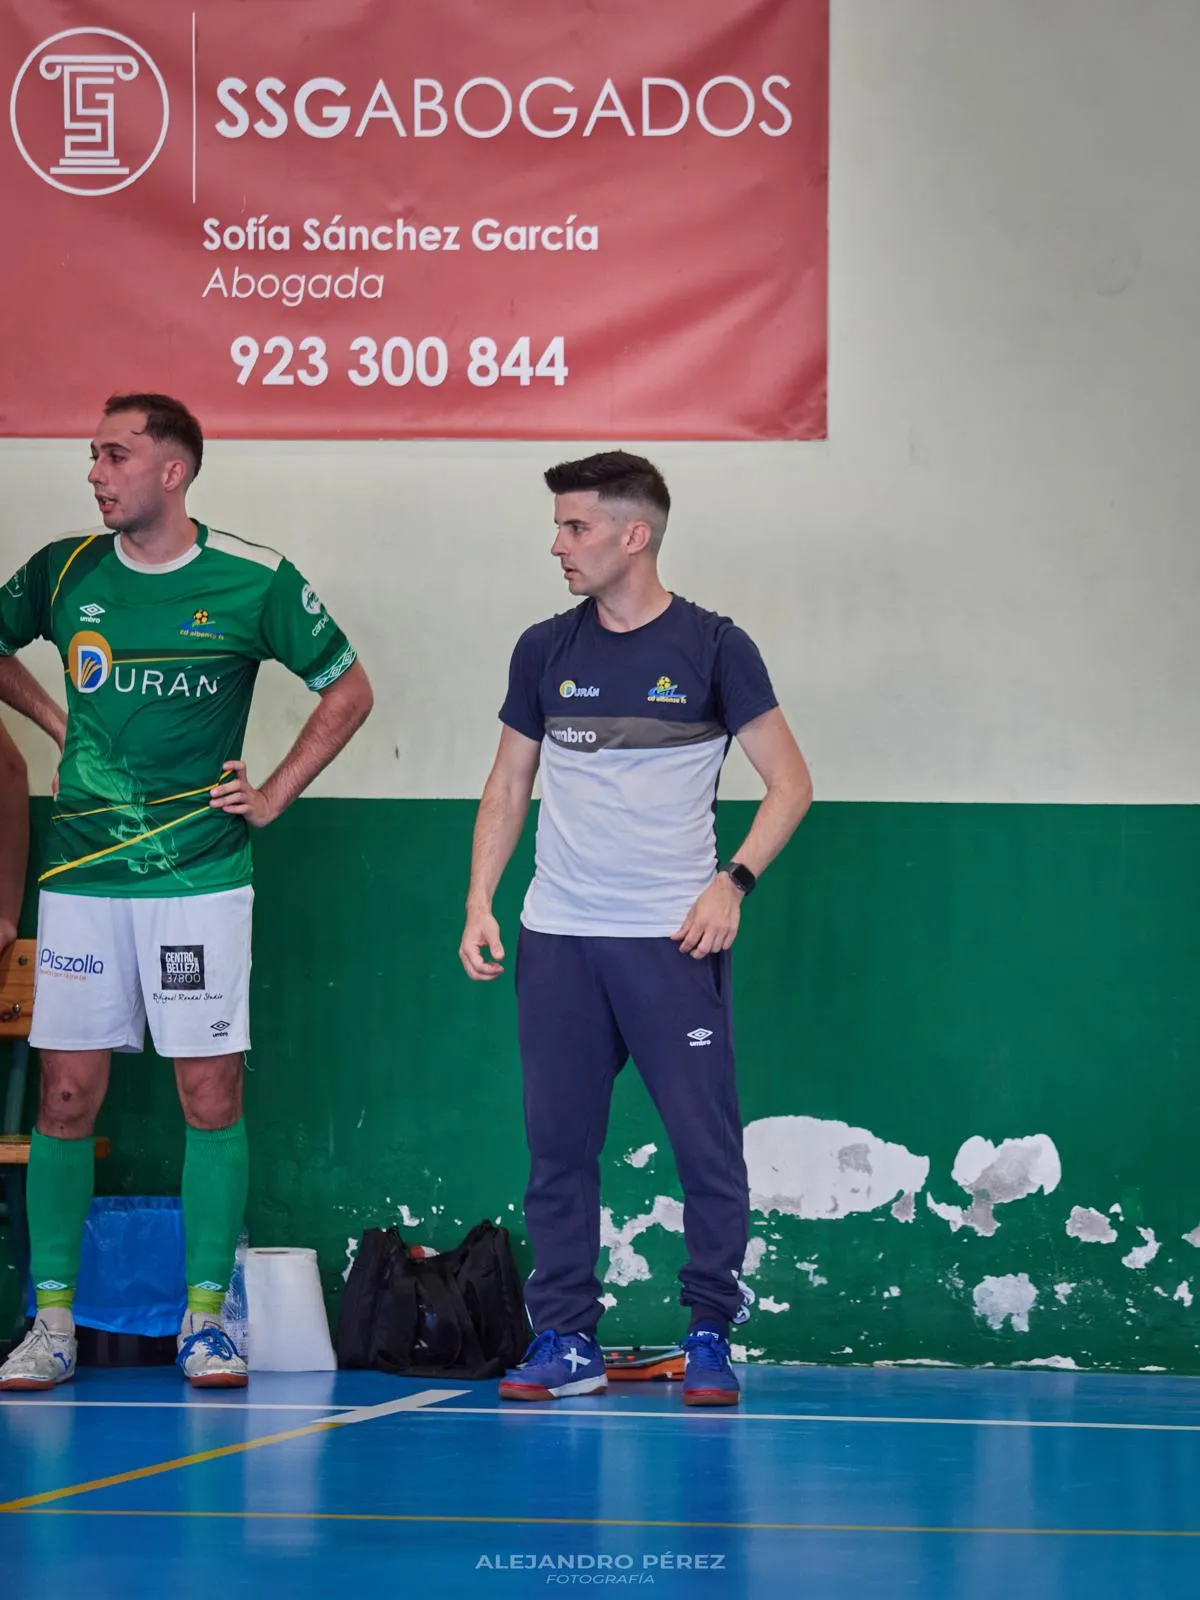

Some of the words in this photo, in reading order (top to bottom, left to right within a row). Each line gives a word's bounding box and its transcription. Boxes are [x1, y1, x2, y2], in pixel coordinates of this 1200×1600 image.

[202, 214, 291, 252] Sofía
[302, 214, 461, 252] Sánchez
[471, 214, 599, 252] García
[201, 266, 385, 307] Abogada
[230, 335, 329, 387] 923
[347, 335, 449, 387] 300
[466, 335, 569, 387] 844
[79, 616, 101, 624] umbro
[40, 948, 104, 975] Piszolla
[165, 951, 194, 963] CENTRO
[166, 962, 200, 974] BELLEZA
[166, 973, 201, 983] 37800
